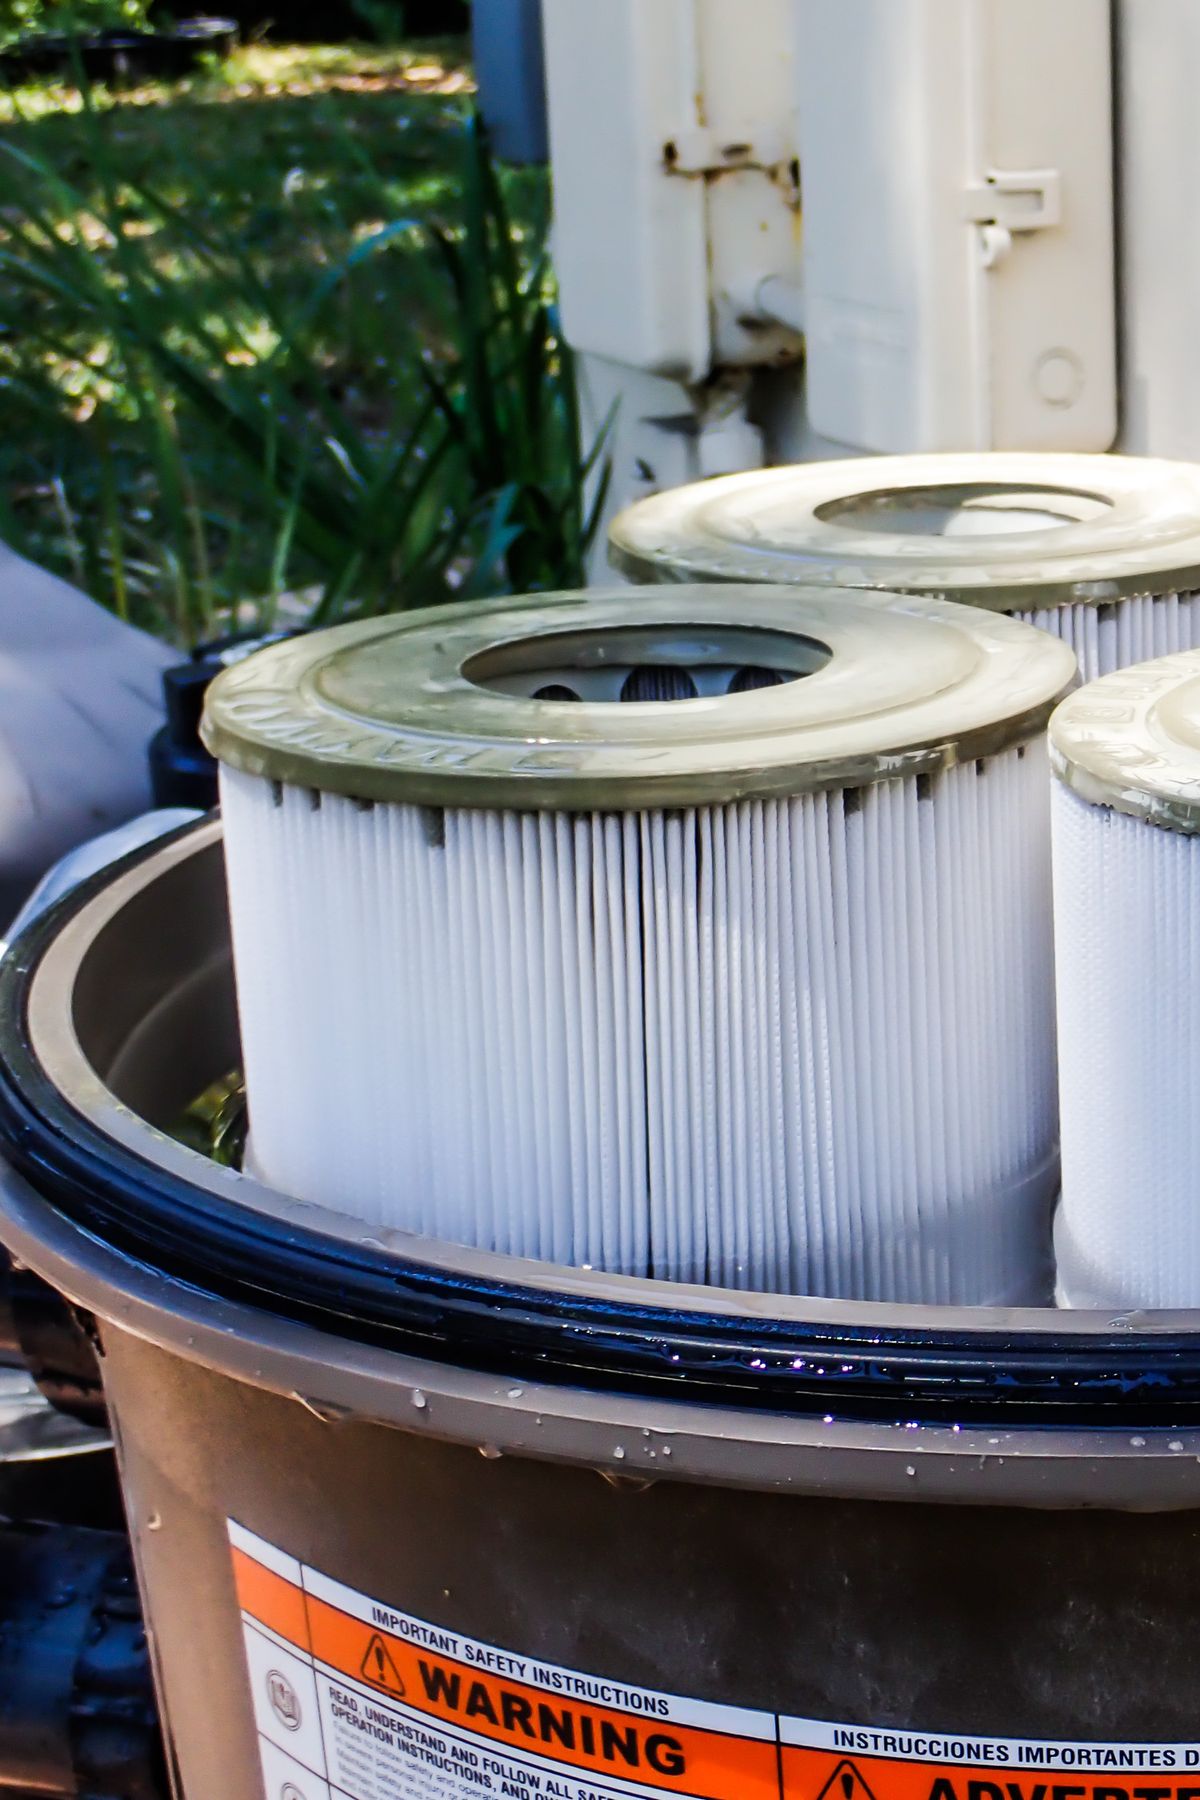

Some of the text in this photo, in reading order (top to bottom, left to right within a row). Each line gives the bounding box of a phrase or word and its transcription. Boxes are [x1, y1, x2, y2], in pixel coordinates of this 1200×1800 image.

[371, 1606, 670, 1717] IMPORTANT SAFETY INSTRUCTIONS
[330, 1702, 394, 1746] OPERATION
[397, 1737, 498, 1793] INSTRUCTIONS,
[501, 1781, 530, 1800] AND
[364, 1705, 447, 1754] UNDERSTAND
[450, 1745, 479, 1767] AND
[482, 1757, 540, 1790] FOLLOW
[545, 1779, 574, 1800] ALL
[417, 1659, 688, 1777] WARNING
[833, 1729, 1010, 1762] INSTRUCCIONES
[1018, 1746, 1176, 1766] IMPORTANTES
